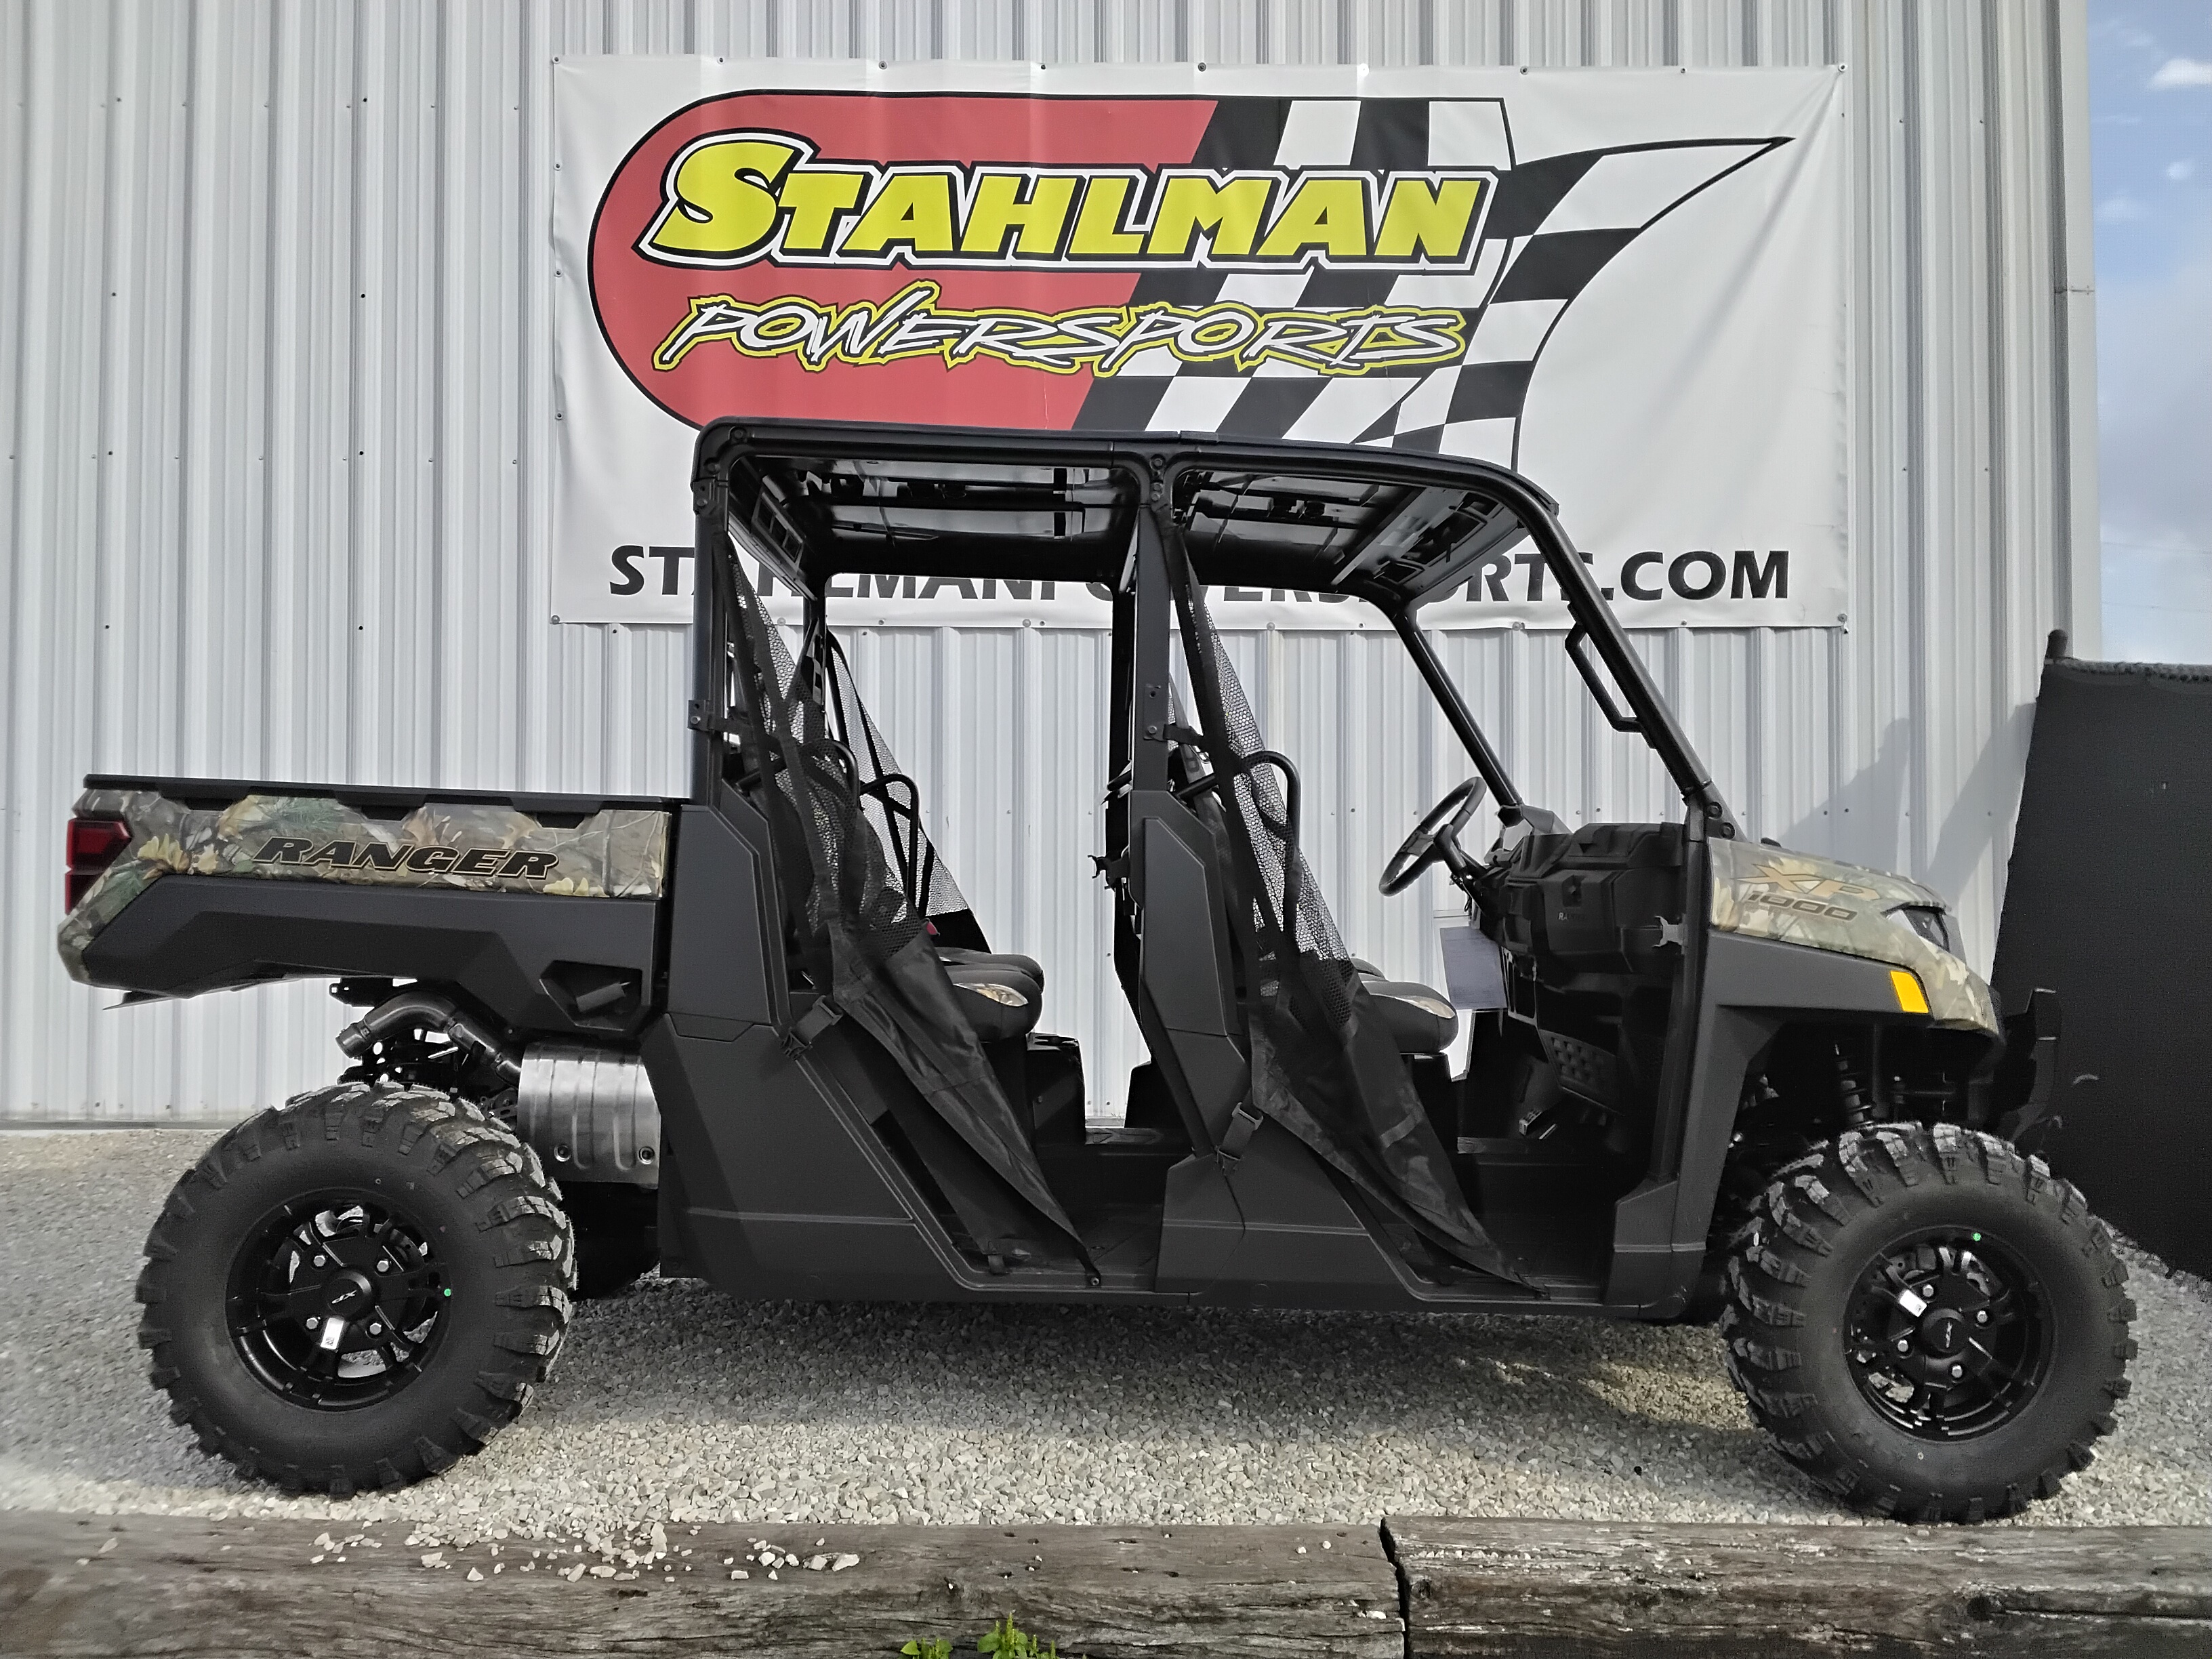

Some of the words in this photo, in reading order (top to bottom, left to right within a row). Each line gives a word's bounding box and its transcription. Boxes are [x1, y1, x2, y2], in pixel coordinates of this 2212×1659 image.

[638, 131, 1495, 267] STAHLMAN
[654, 281, 1466, 377] POWERSPORTS
[251, 836, 560, 880] RANGER
[1737, 863, 1882, 901] XP
[1747, 891, 1858, 921] 1000
